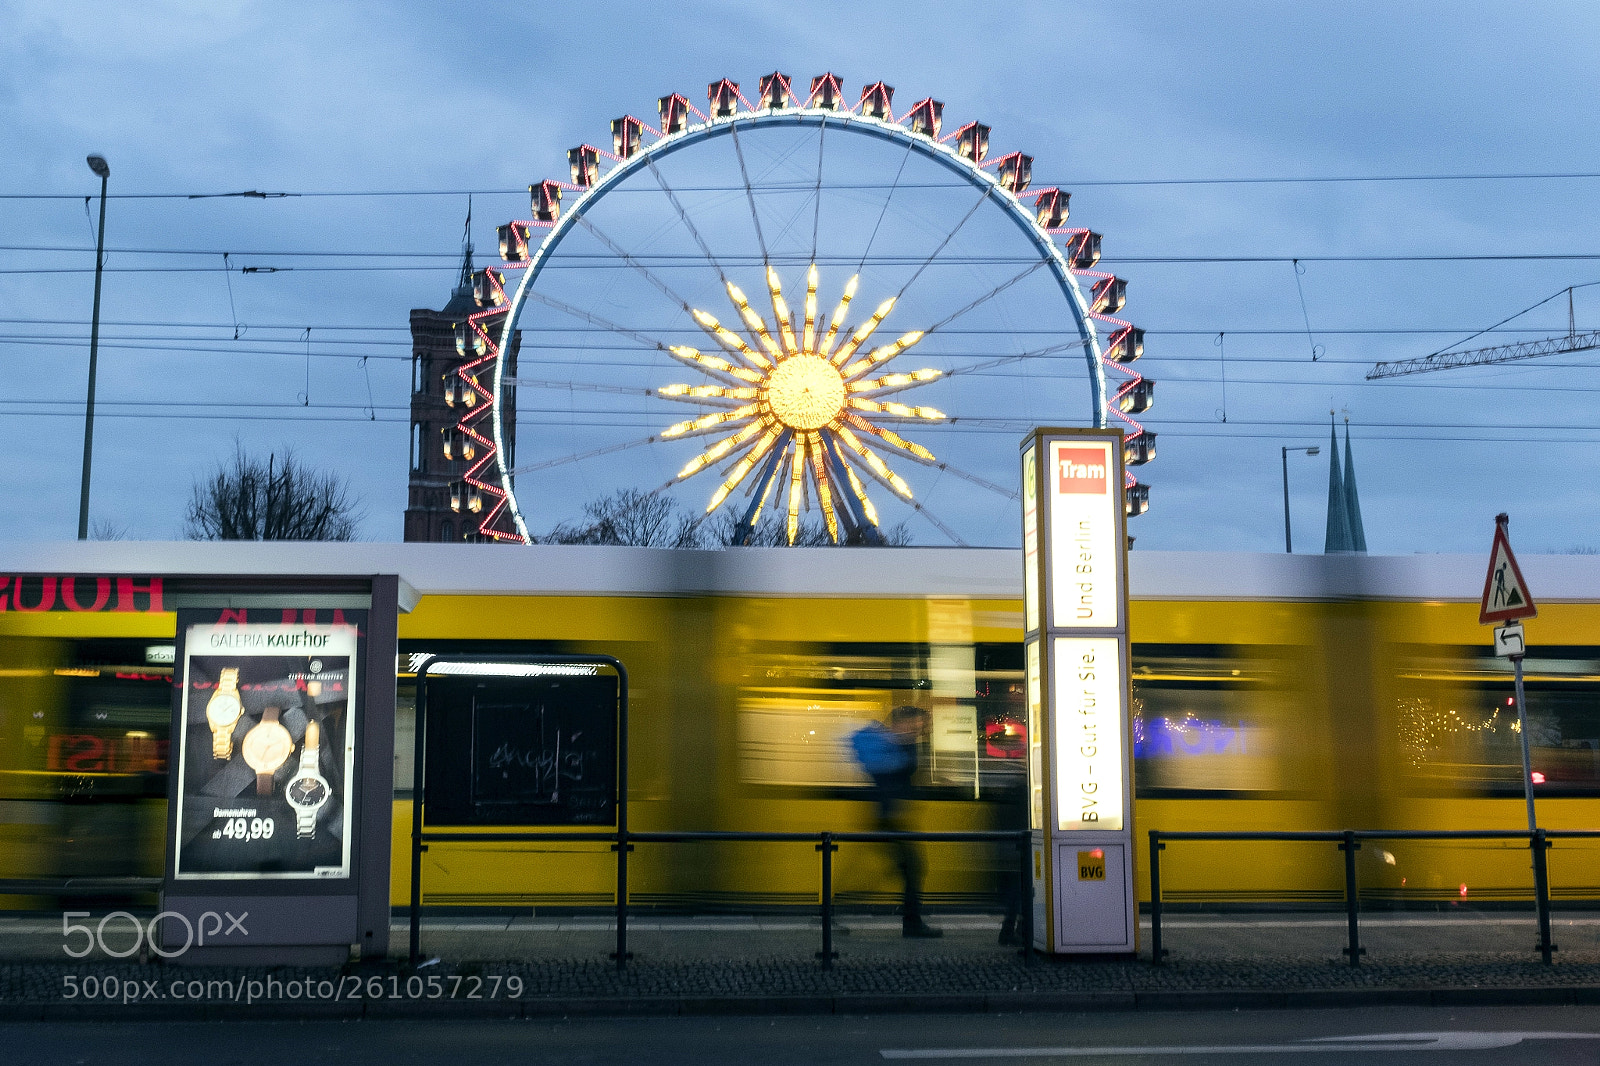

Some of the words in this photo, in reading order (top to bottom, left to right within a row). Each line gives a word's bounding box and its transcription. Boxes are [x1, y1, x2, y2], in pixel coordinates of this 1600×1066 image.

[1060, 459, 1105, 479] Tram
[1075, 582, 1093, 619] Und
[210, 633, 264, 648] GALERIA
[1078, 648, 1096, 681] Sie.
[1080, 724, 1097, 758] Gut
[1081, 782, 1099, 823] BVG
[212, 828, 222, 839] ab
[222, 817, 275, 843] 49,99
[1081, 866, 1103, 878] BVG
